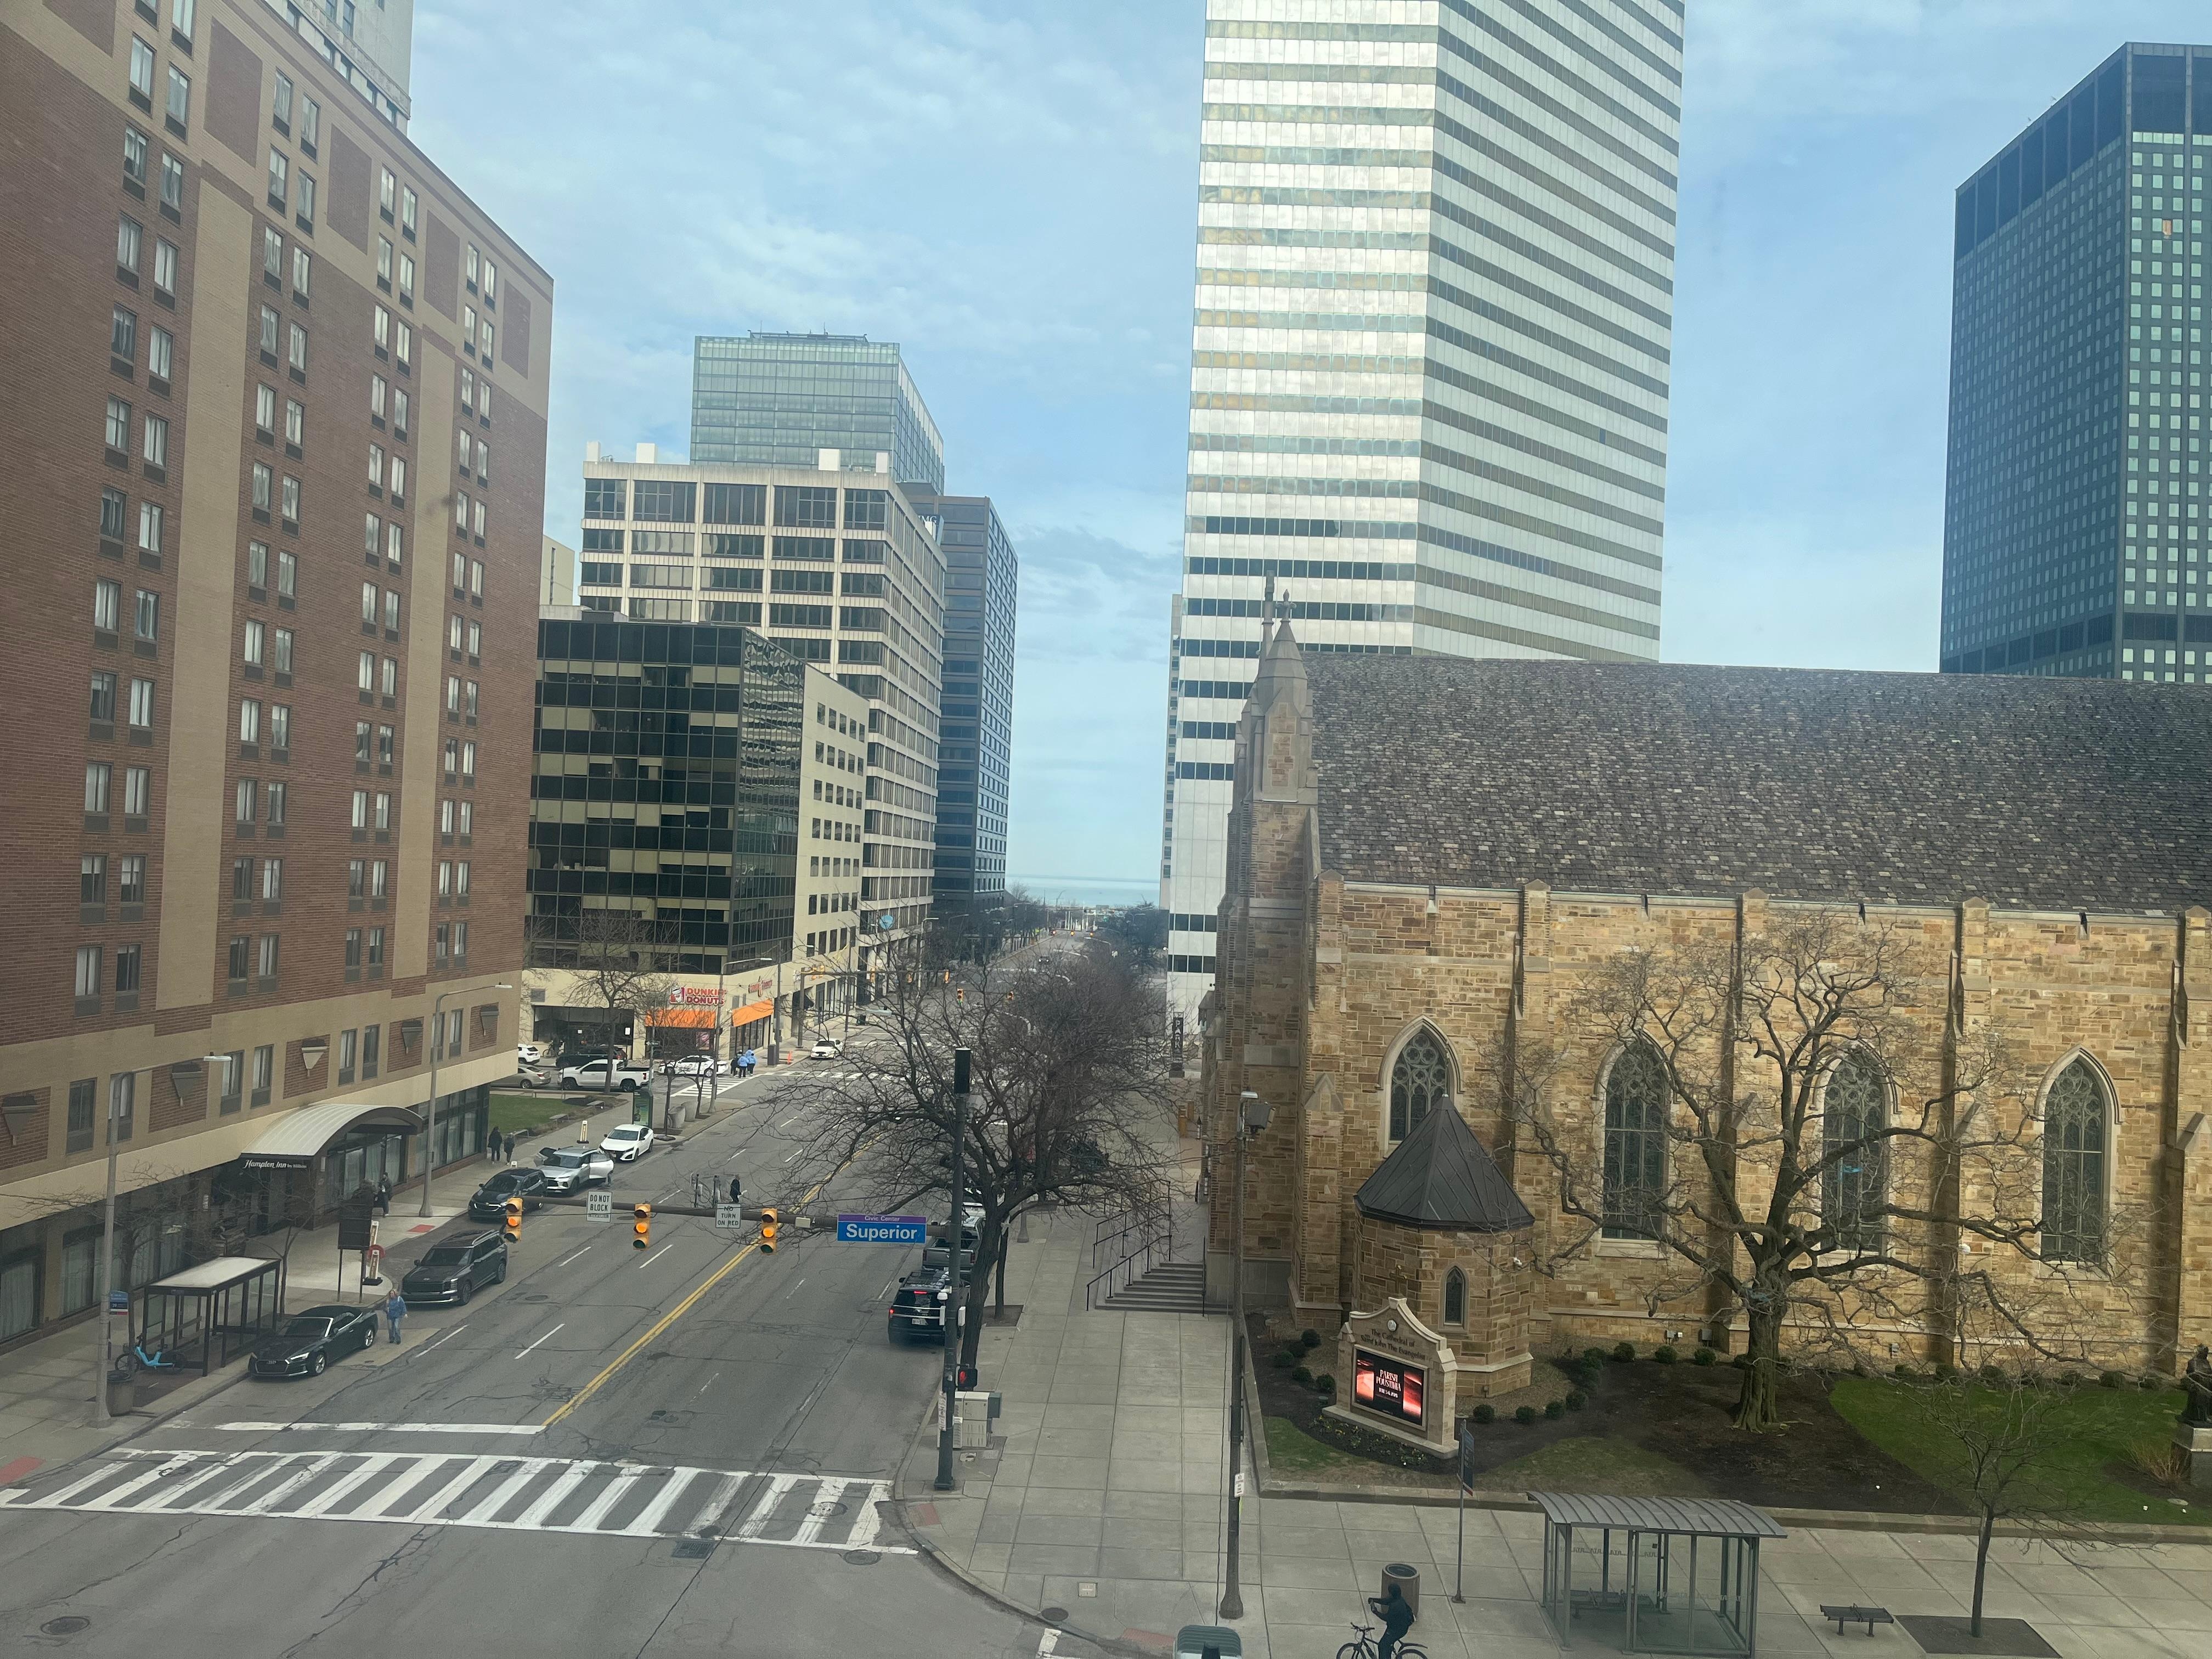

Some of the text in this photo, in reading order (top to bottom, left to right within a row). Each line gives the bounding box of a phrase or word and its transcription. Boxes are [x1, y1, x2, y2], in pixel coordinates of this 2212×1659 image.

[242, 1159, 275, 1170] Hampton
[846, 1223, 917, 1241] Superior
[1372, 1329, 1381, 1338] The
[1382, 1332, 1408, 1346] Cathedral
[1387, 1342, 1397, 1352] The
[1398, 1347, 1425, 1361] Evangelist
[1380, 1369, 1398, 1383] PARISH
